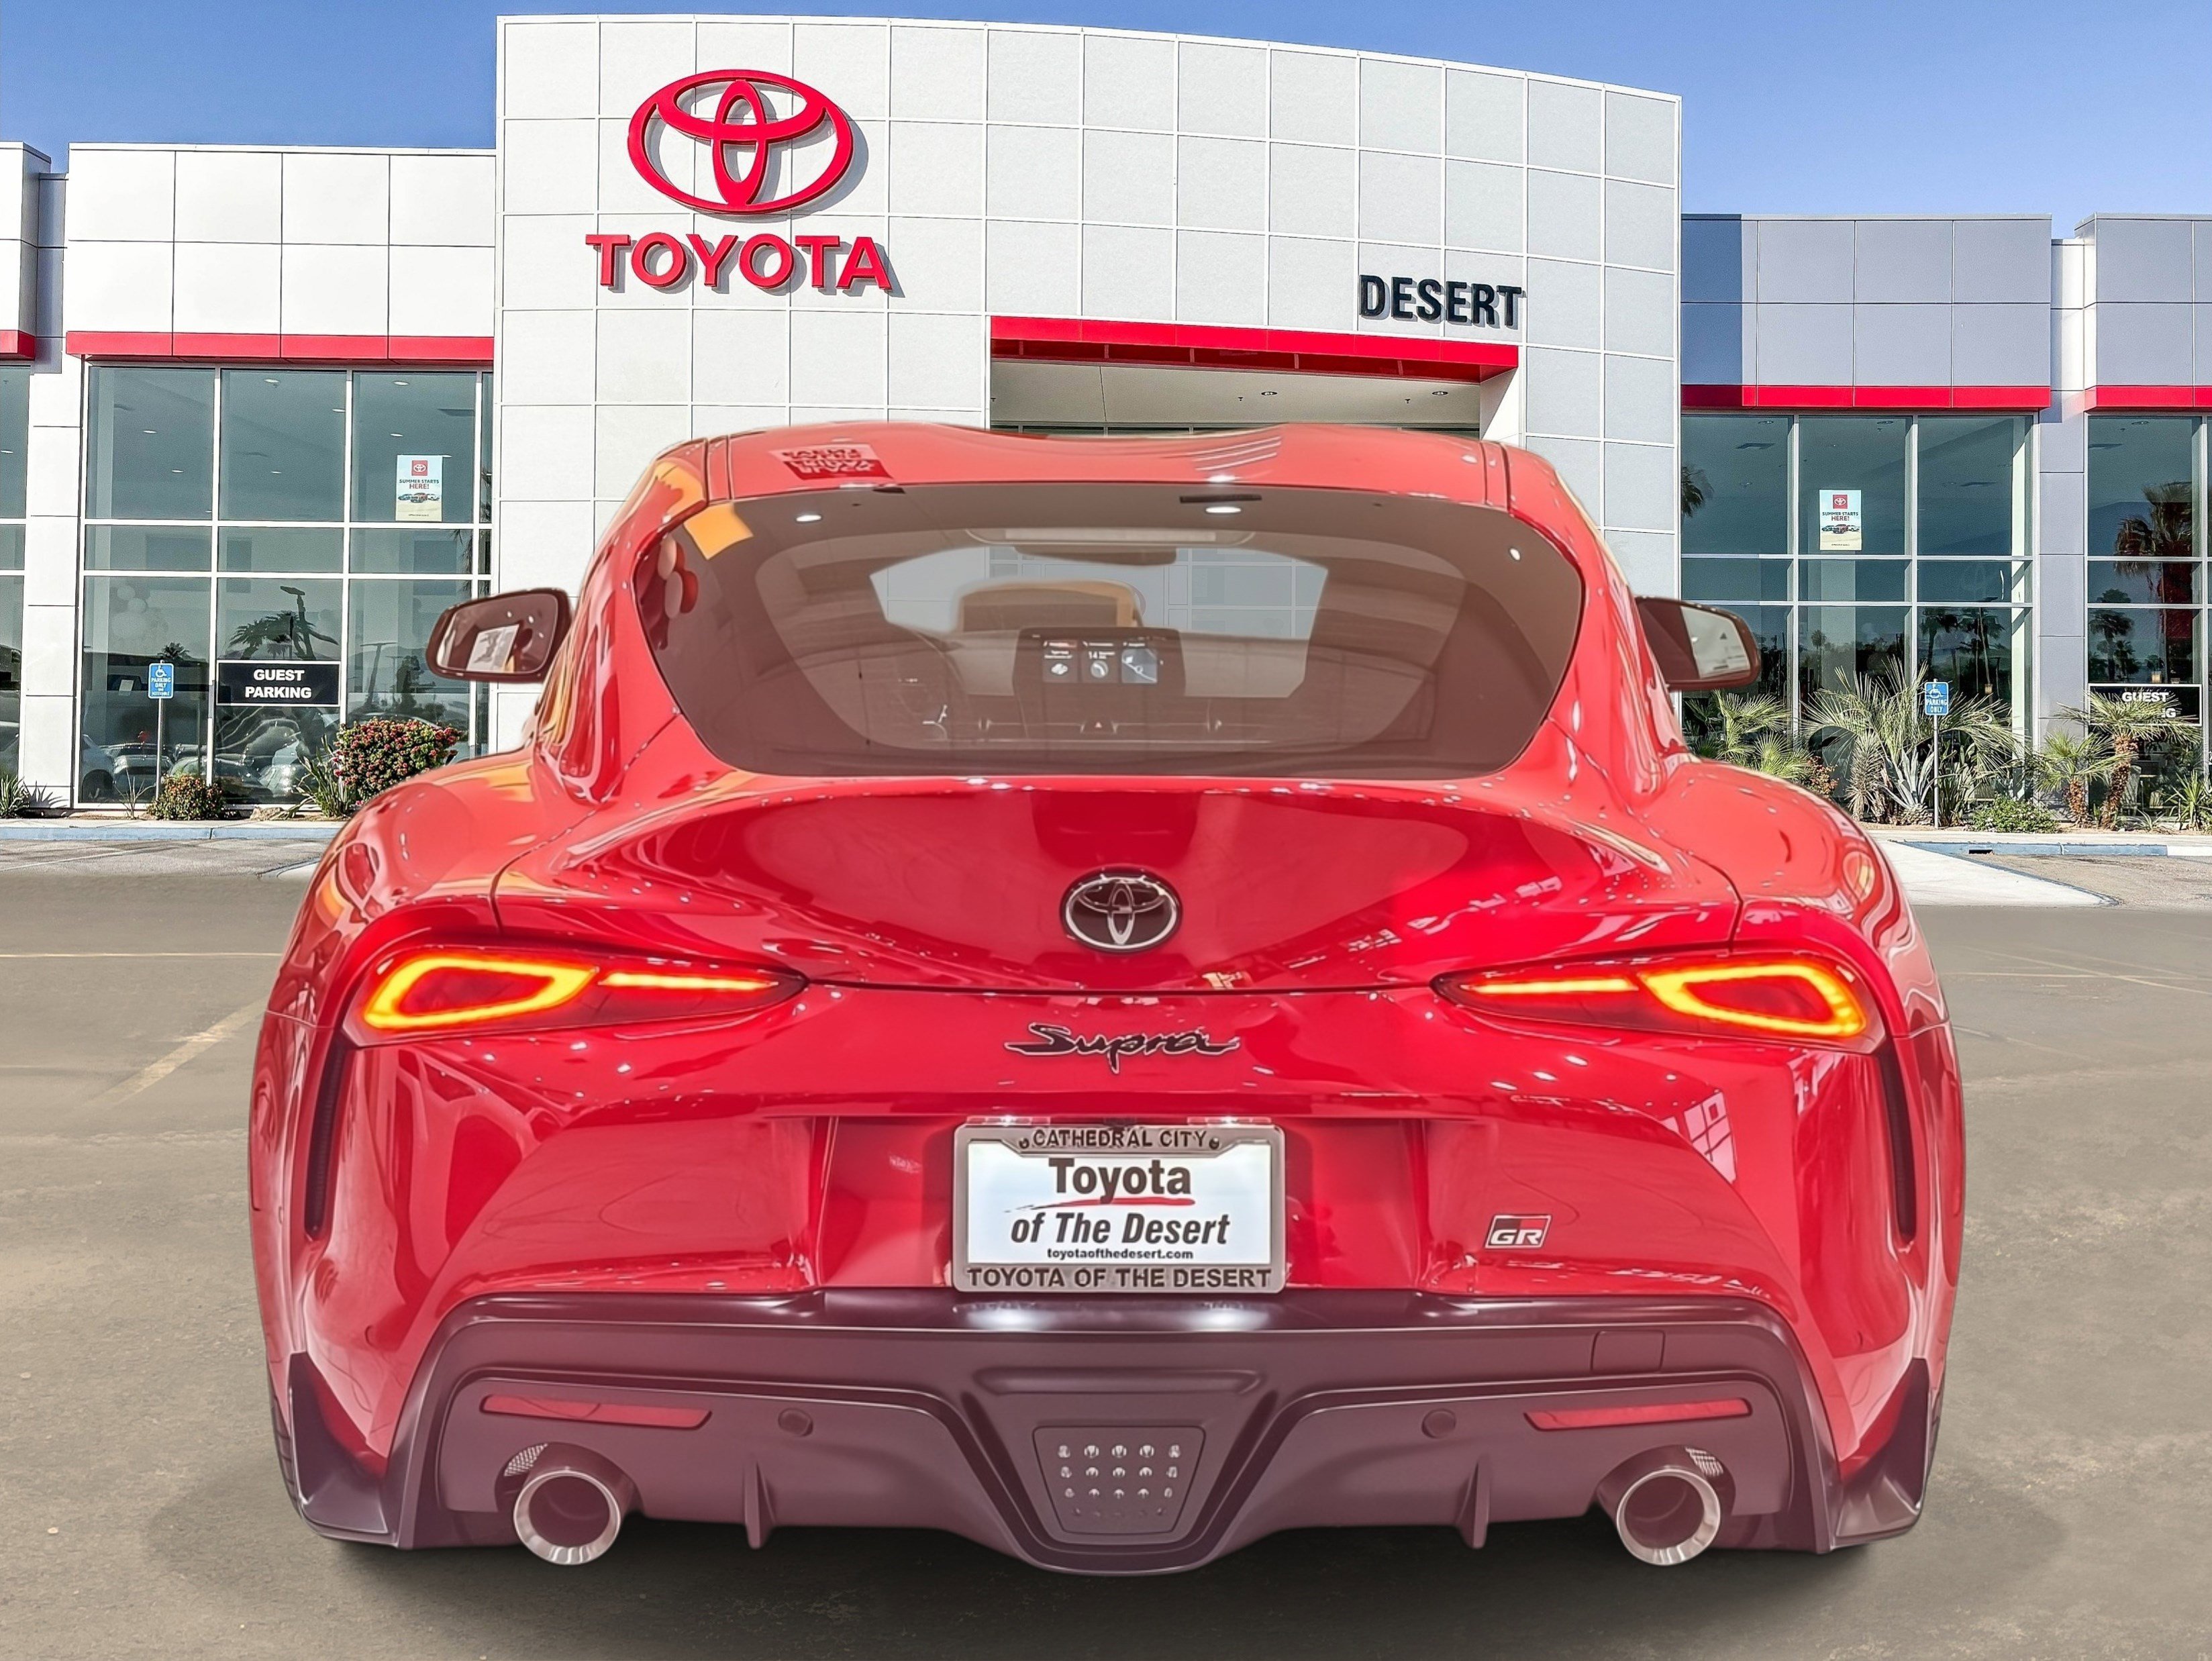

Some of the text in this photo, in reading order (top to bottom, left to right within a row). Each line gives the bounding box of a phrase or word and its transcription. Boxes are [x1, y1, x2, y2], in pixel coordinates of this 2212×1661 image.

[585, 232, 893, 290] TOYOTA
[1359, 274, 1523, 327] DESERT
[253, 669, 305, 681] GUEST
[245, 687, 312, 699] PARKING
[2121, 692, 2169, 702] GUEST
[1930, 705, 1943, 713] ONLY
[1005, 1022, 1240, 1074] Supra
[1032, 1129, 1208, 1148] CATHEDRAL CITY
[1048, 1158, 1192, 1205] Toyota
[1011, 1213, 1231, 1245] of The Desert
[1490, 1229, 1544, 1245] GR
[1047, 1248, 1194, 1260] toyotaofthedesert.com
[968, 1268, 1272, 1288] TOYOTA OF THE DESERT
